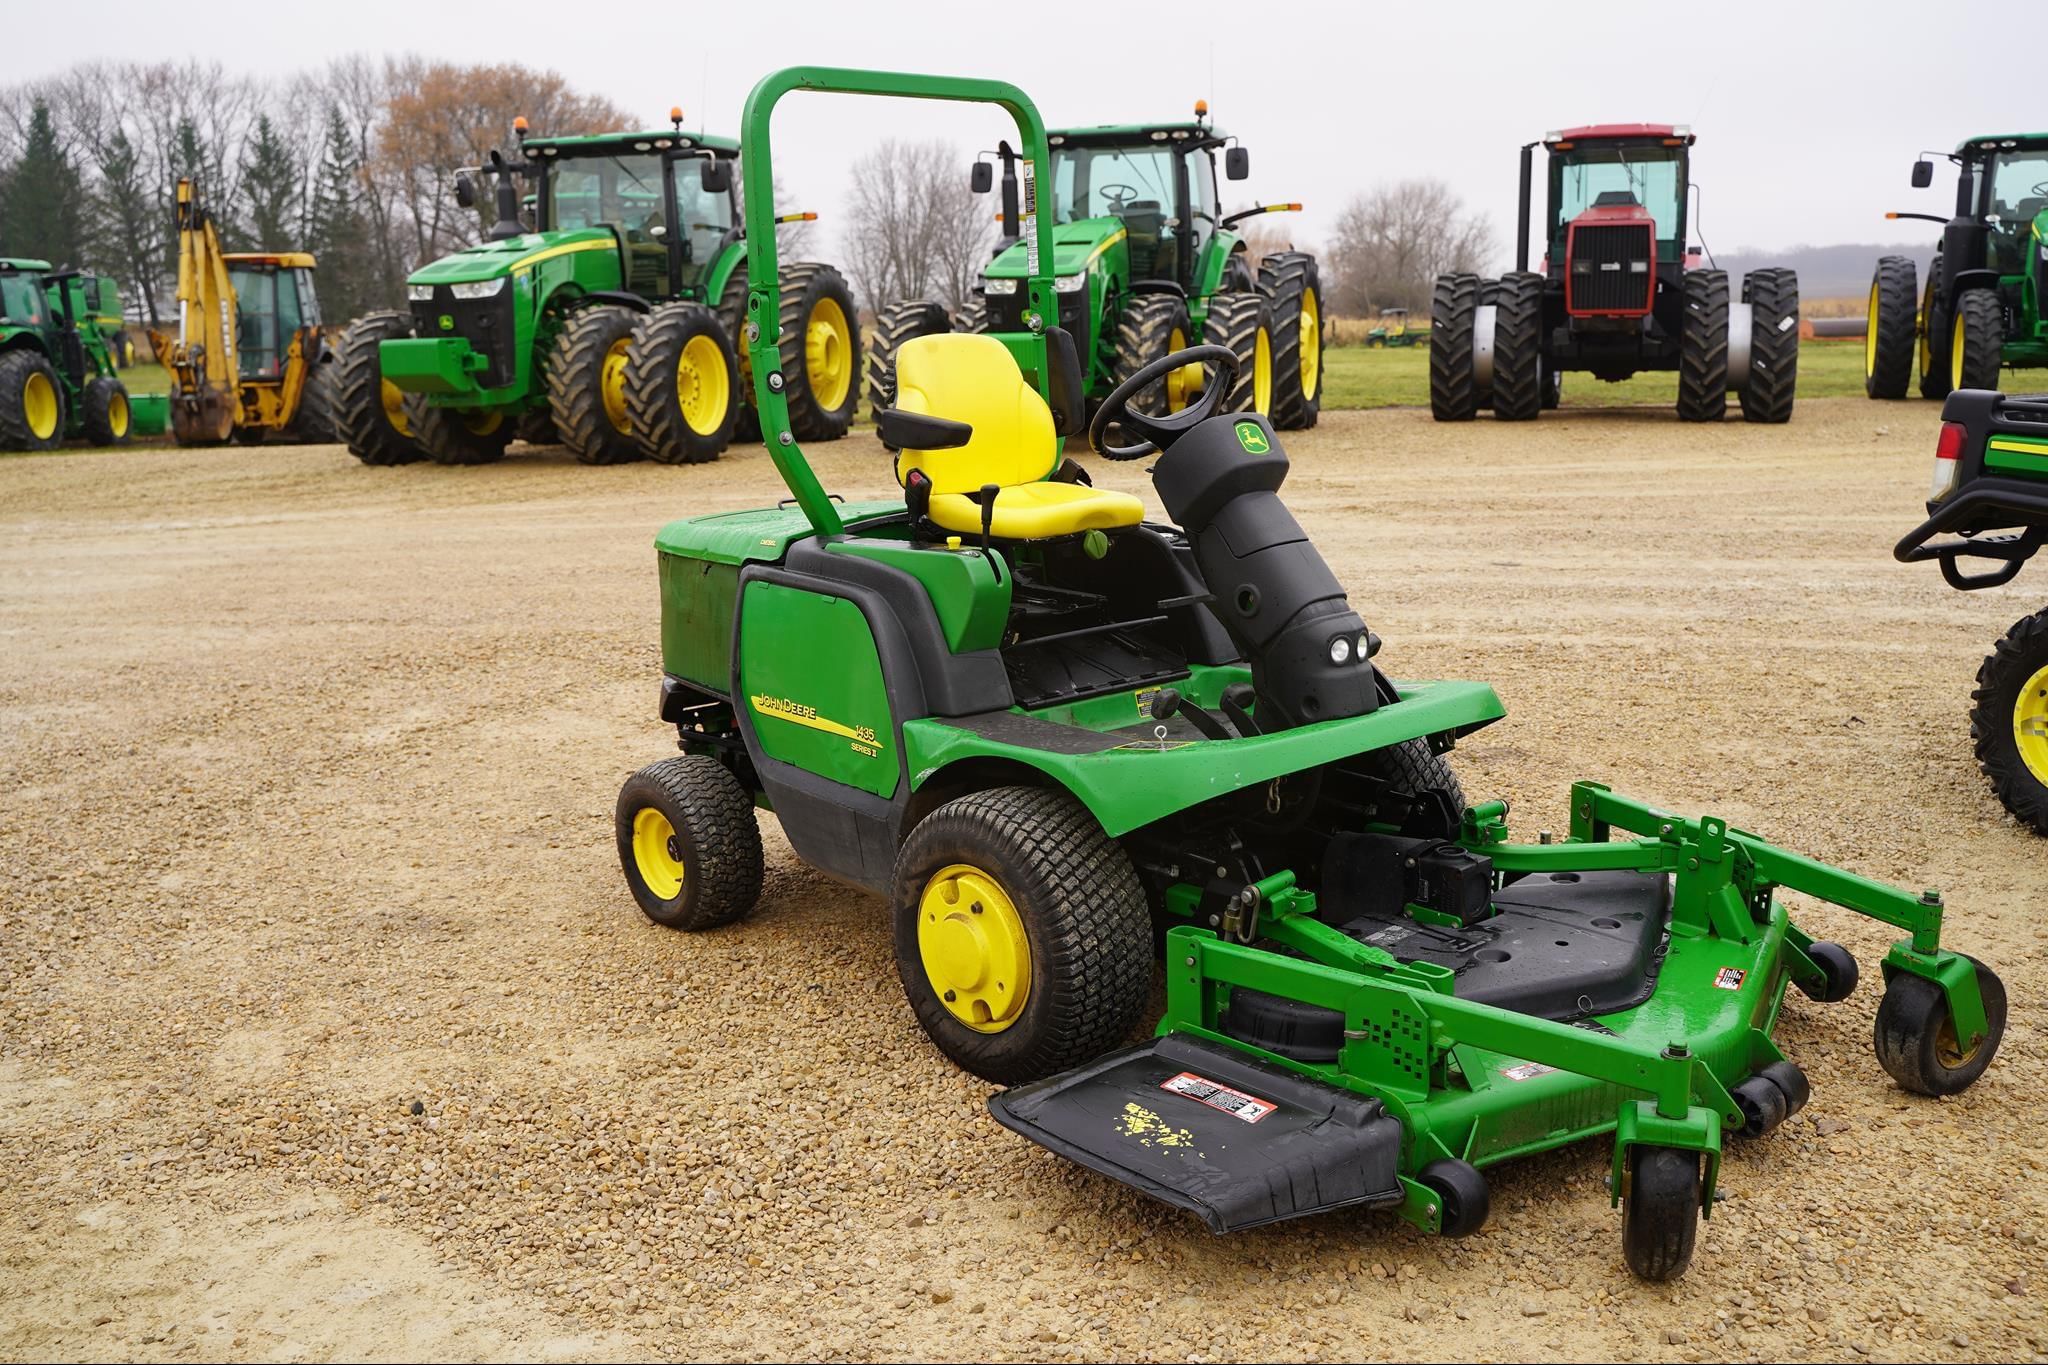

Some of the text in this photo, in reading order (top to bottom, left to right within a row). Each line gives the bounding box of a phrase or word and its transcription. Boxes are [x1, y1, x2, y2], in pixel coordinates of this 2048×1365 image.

[758, 692, 816, 720] JOHN DEERE
[856, 725, 875, 742] 1435
[851, 742, 871, 756] SERIES
